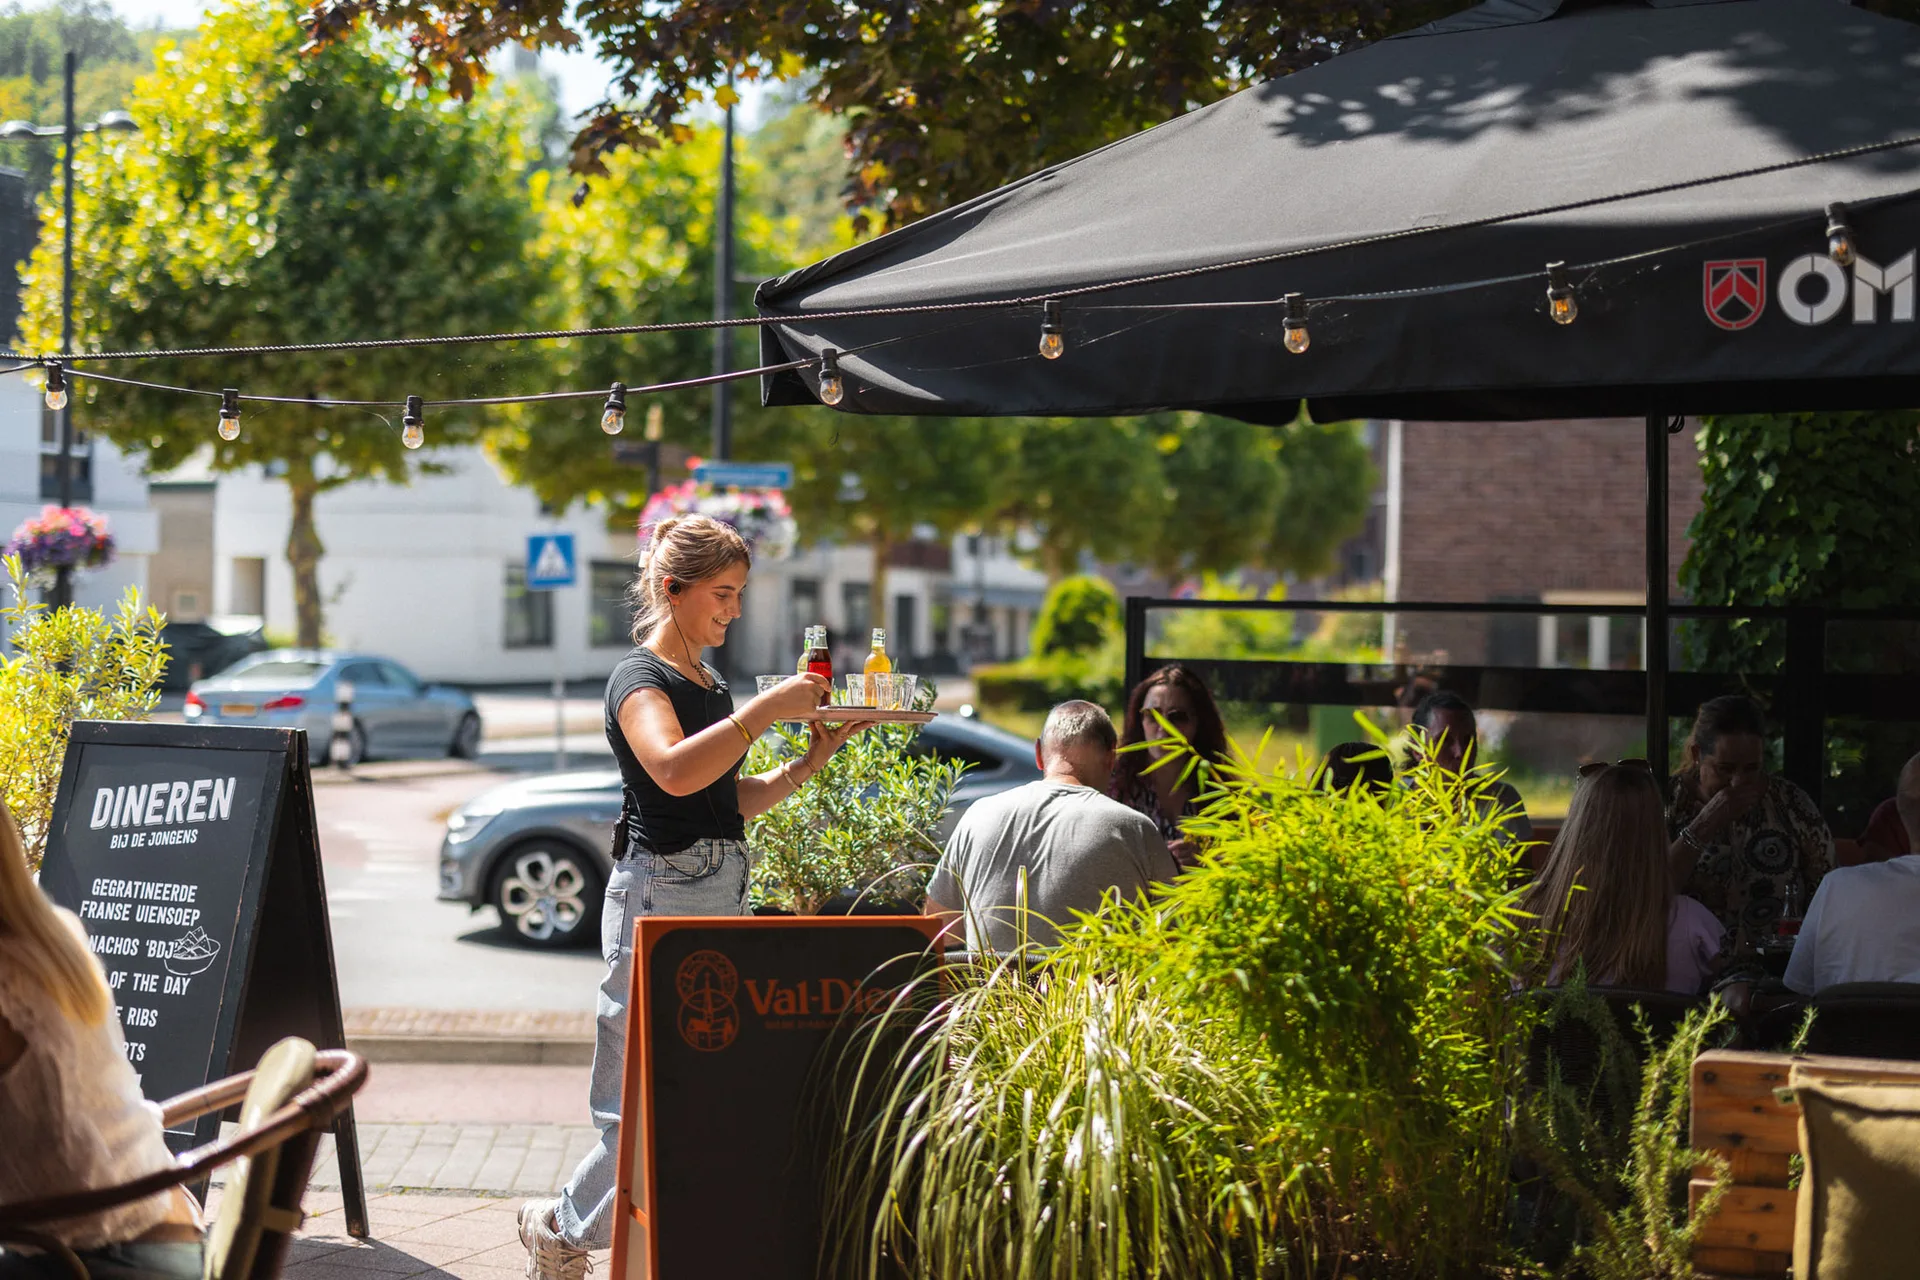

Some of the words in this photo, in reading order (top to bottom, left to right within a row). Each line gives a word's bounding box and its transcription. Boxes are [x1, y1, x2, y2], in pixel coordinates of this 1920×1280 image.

[1777, 248, 1916, 326] OM
[90, 777, 237, 830] DINEREN
[110, 835, 129, 849] BIJ
[131, 833, 146, 848] DE
[148, 829, 199, 847] JONGENS
[91, 878, 198, 902] GEGRATINEERDE
[80, 900, 132, 922] FRANSE
[135, 904, 200, 926] UIENSOEP
[88, 935, 140, 956] NACHOS
[109, 970, 127, 989] OF
[133, 973, 159, 993] THE
[163, 976, 191, 996] DAY
[126, 1006, 158, 1027] RIBS
